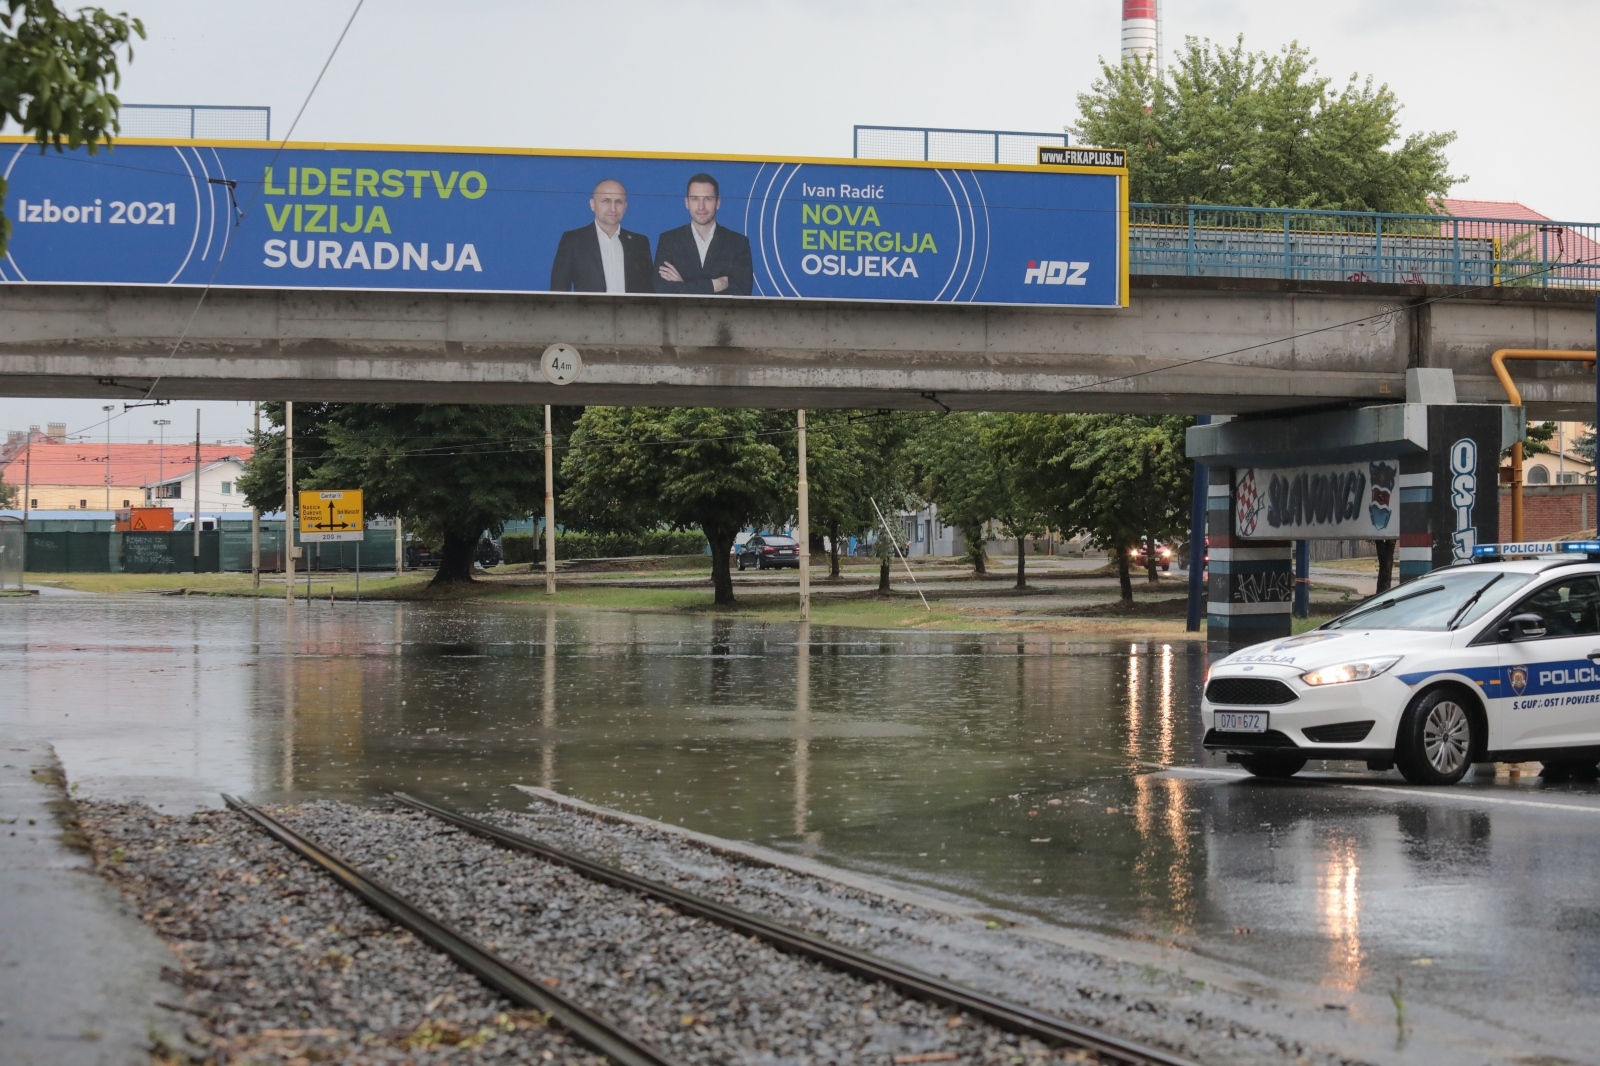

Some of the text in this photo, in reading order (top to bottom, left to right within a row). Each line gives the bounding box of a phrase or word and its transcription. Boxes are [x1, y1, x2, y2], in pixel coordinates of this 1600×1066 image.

[1041, 150, 1124, 166] www.FRKAPLUS.hr
[264, 166, 488, 199] LIDERSTVO
[802, 182, 884, 199] Ivan Radić
[18, 199, 176, 225] Izbori 2021
[264, 203, 392, 234] VIZIJA
[802, 203, 881, 226] NOVA
[802, 229, 938, 254] ENERGIJA
[263, 239, 483, 272] SURADNJA
[801, 254, 919, 278] OSIJEKA
[1024, 260, 1090, 286] HDZ
[1503, 544, 1553, 554] POLICIJA
[1227, 655, 1297, 665] POLICIJA
